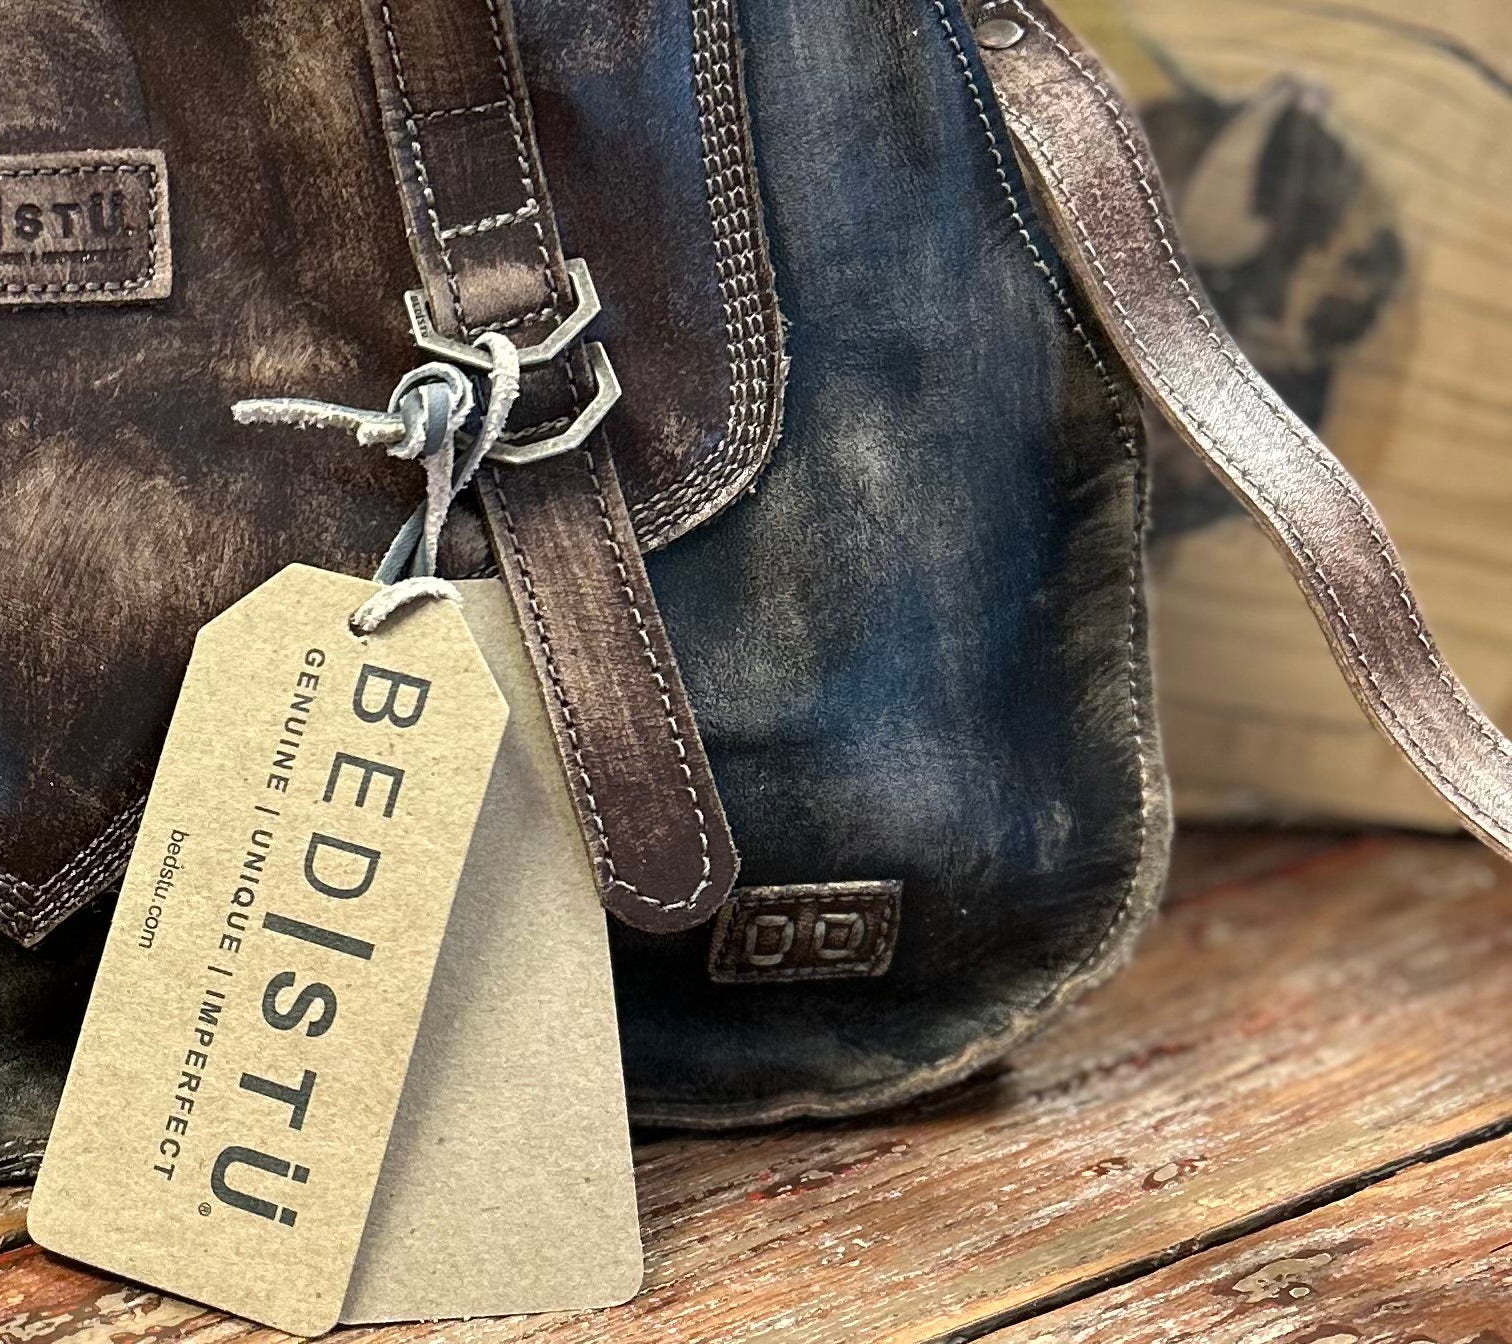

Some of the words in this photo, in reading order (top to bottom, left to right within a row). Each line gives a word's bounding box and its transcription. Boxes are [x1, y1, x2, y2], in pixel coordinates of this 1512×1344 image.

[266, 648, 326, 794] GENUINE
[138, 829, 190, 949] bedstu.com
[218, 829, 274, 954] UNIQUE
[153, 989, 226, 1181] IMPERFECT
